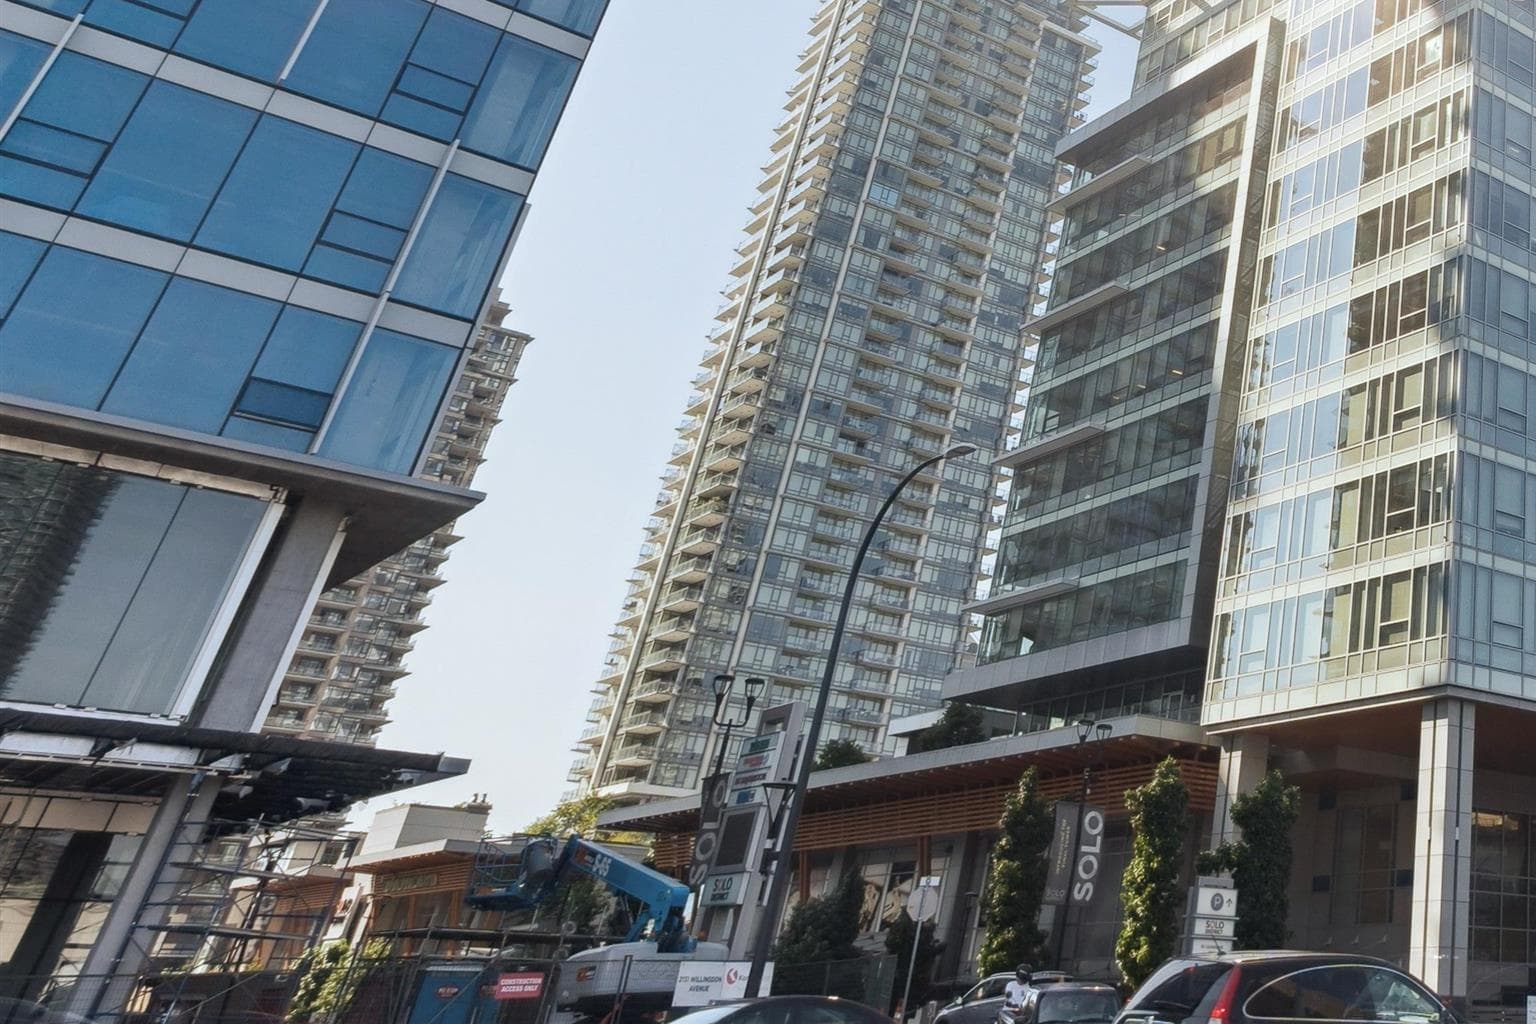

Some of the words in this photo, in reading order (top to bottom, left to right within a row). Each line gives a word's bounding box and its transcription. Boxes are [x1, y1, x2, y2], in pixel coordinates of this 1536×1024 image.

[1073, 810, 1104, 902] SOLO
[713, 877, 733, 892] SOLO
[1205, 919, 1225, 929] SOLO
[500, 977, 543, 986] CONSTRUCTION
[500, 985, 524, 993] ACCESS
[523, 984, 539, 992] ONLY
[687, 985, 710, 993] AVENUE
